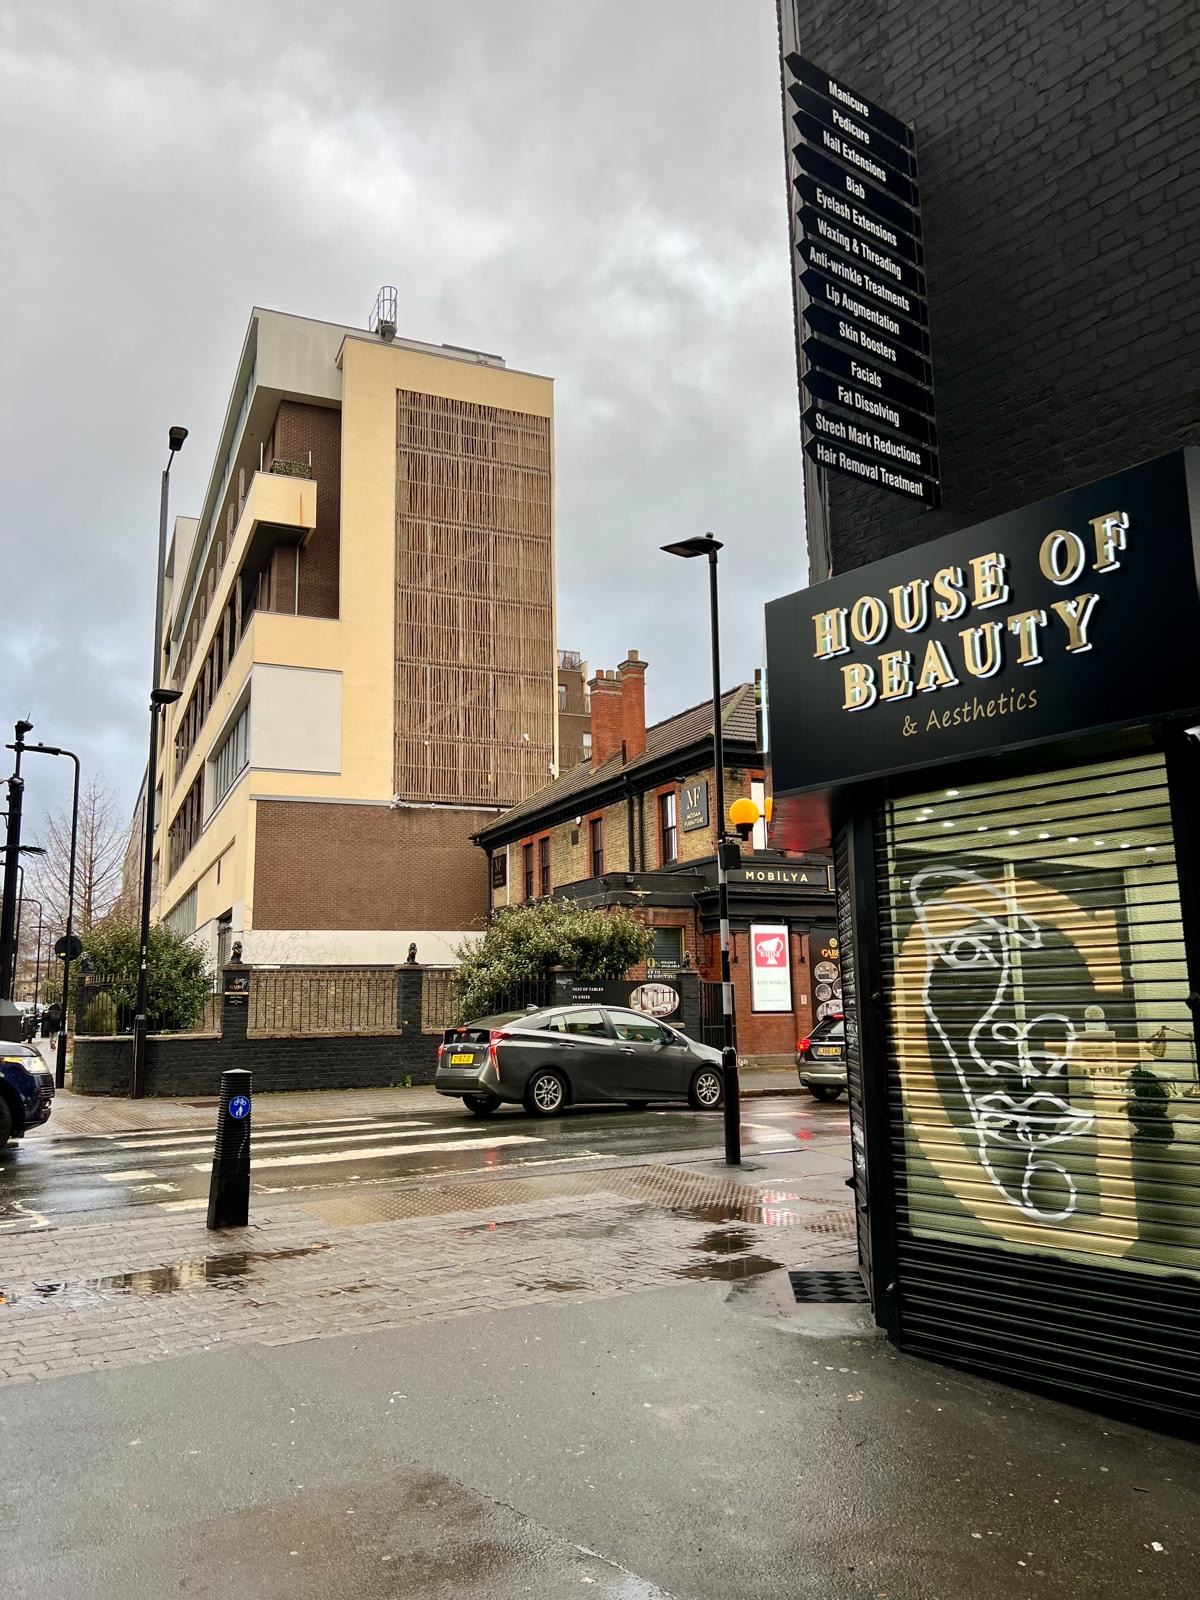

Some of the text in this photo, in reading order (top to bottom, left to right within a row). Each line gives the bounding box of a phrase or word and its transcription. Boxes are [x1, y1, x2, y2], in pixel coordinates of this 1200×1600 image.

[829, 80, 869, 117] Manicure
[832, 109, 870, 144] Pedicure
[823, 130, 887, 182] Nail Extensions
[846, 176, 865, 200] Biab
[816, 188, 897, 247] Eyelash Extensions
[817, 218, 902, 280] Waxing & Threading
[809, 246, 910, 311] Anti-wrinkle Treatments
[826, 283, 900, 335] Lip Augmentation
[839, 322, 897, 362] Skin Boosters
[851, 361, 882, 388] Facials
[838, 385, 900, 427] Fat Dissolving
[815, 413, 921, 466] Strech Mark Reductions
[817, 443, 924, 497] Hair Removal Treatment
[811, 510, 1130, 660] HOUSE OF
[840, 593, 1101, 712] BEAUTY
[902, 687, 1039, 737] & Aesthetics
